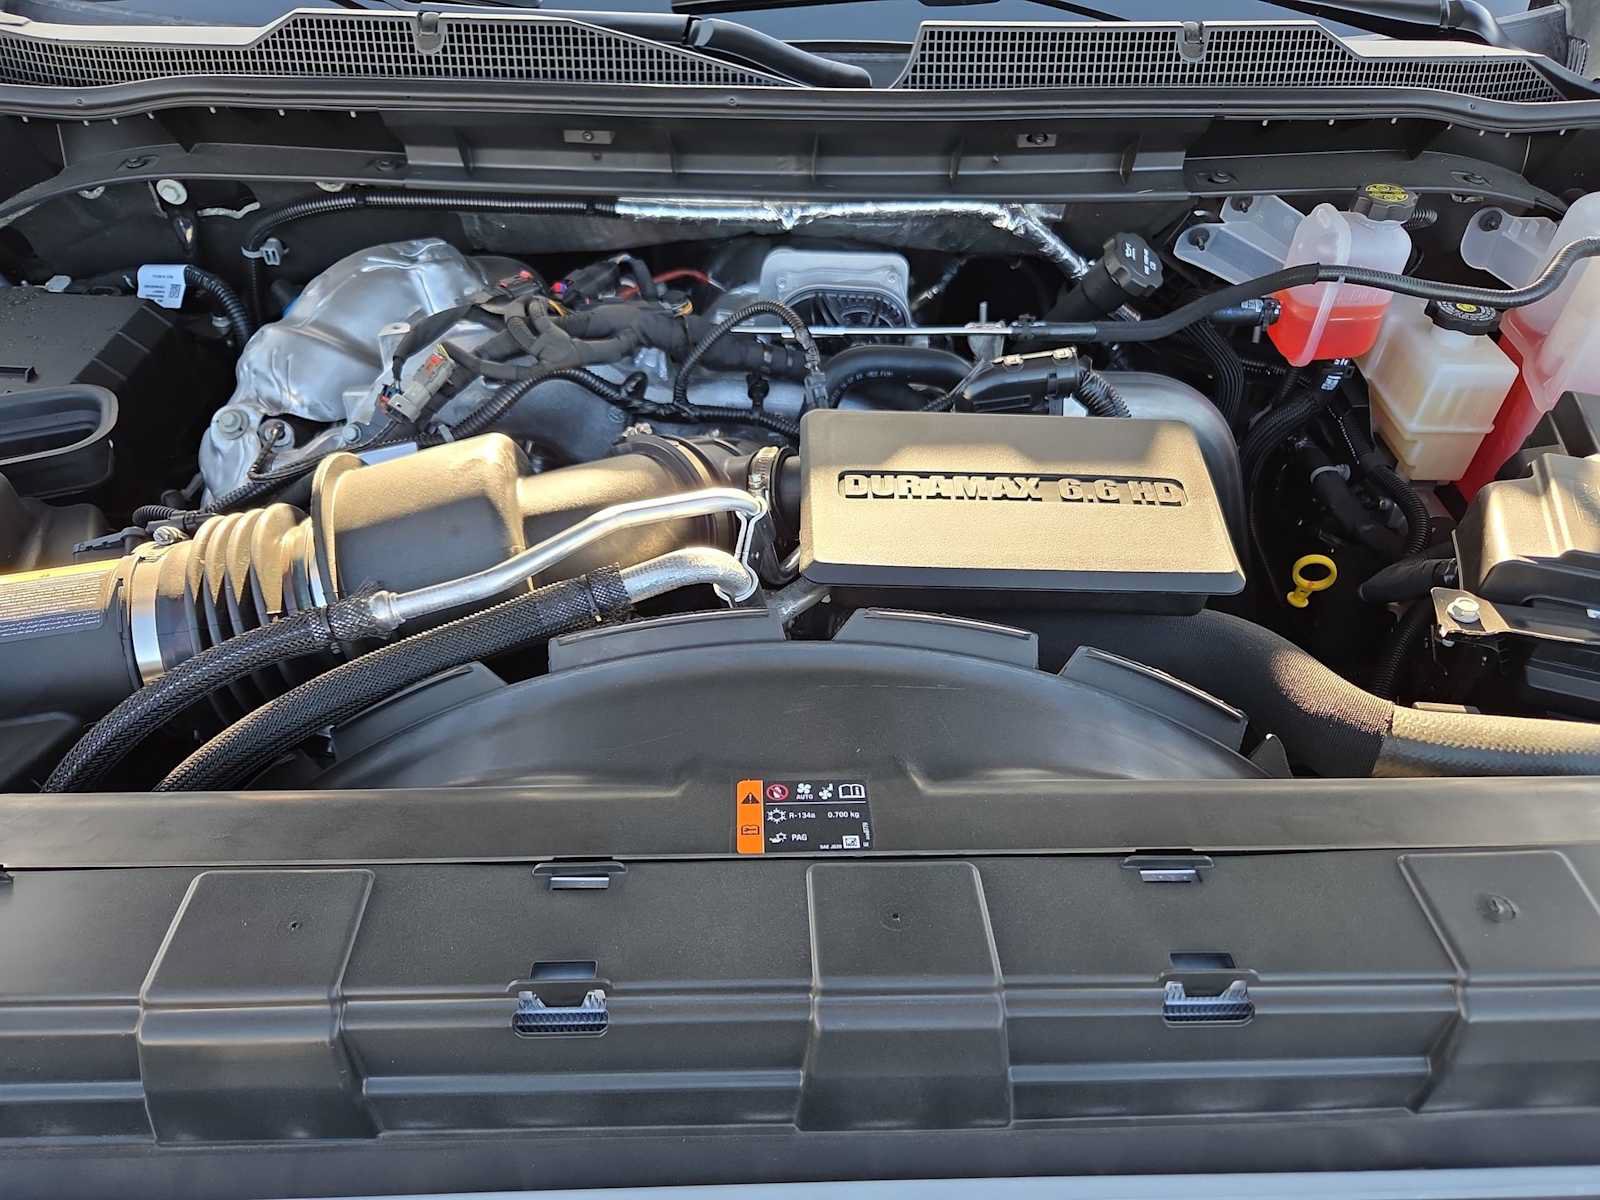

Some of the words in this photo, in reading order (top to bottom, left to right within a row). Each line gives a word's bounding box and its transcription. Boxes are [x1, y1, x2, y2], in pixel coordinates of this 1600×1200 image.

[844, 474, 1042, 501] DURAMAX
[1057, 478, 1120, 503] 6.6
[1128, 480, 1183, 506] HD
[827, 811, 849, 819] 0.700
[850, 811, 860, 819] kg
[791, 833, 808, 841] PAG
